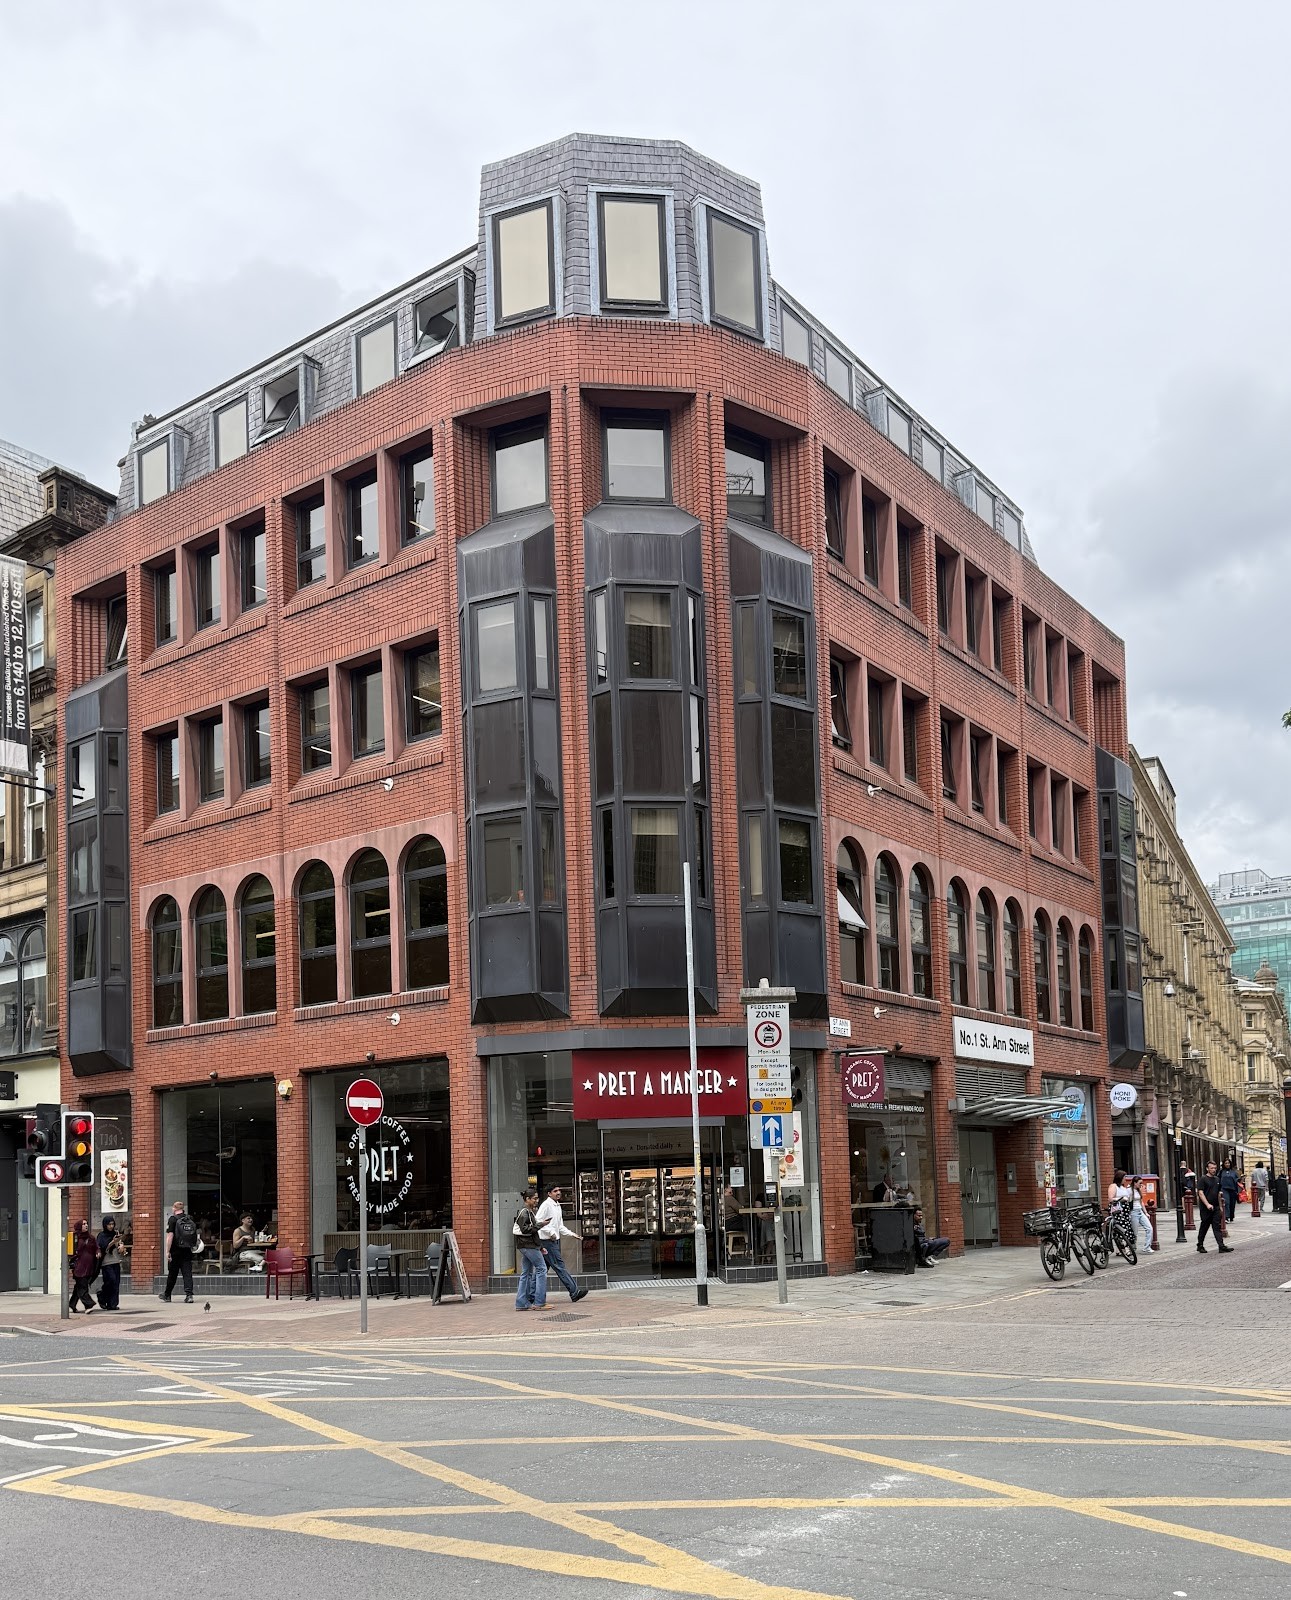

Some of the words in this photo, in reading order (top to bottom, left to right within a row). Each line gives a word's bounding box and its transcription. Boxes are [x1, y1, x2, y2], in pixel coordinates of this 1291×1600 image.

[12, 581, 24, 598] sq
[11, 600, 25, 642] 12,710
[12, 645, 24, 660] to
[13, 661, 27, 697] 6,140
[14, 703, 26, 730] from
[833, 1026, 849, 1036] STREET
[839, 1019, 849, 1028] ANN
[960, 1030, 977, 1047] No.1
[980, 1033, 991, 1049] St.
[993, 1036, 1007, 1051] Ann
[1009, 1038, 1030, 1055] Street
[846, 1059, 863, 1074] ORGANIC
[864, 1059, 879, 1073] COFFEE
[598, 1071, 637, 1097] PRET
[643, 1072, 654, 1096] A
[661, 1069, 723, 1095] MANGER
[852, 1071, 873, 1088] PRET
[845, 1083, 860, 1100] FRESHLY
[872, 1082, 880, 1095] FOOD
[869, 1102, 884, 1110] COFFEE
[888, 1103, 903, 1112] FRESHLY
[903, 1105, 914, 1113] MADE
[381, 1115, 410, 1146] COFFEE
[375, 1197, 399, 1214] MADE
[397, 1171, 413, 1201] FOOD
